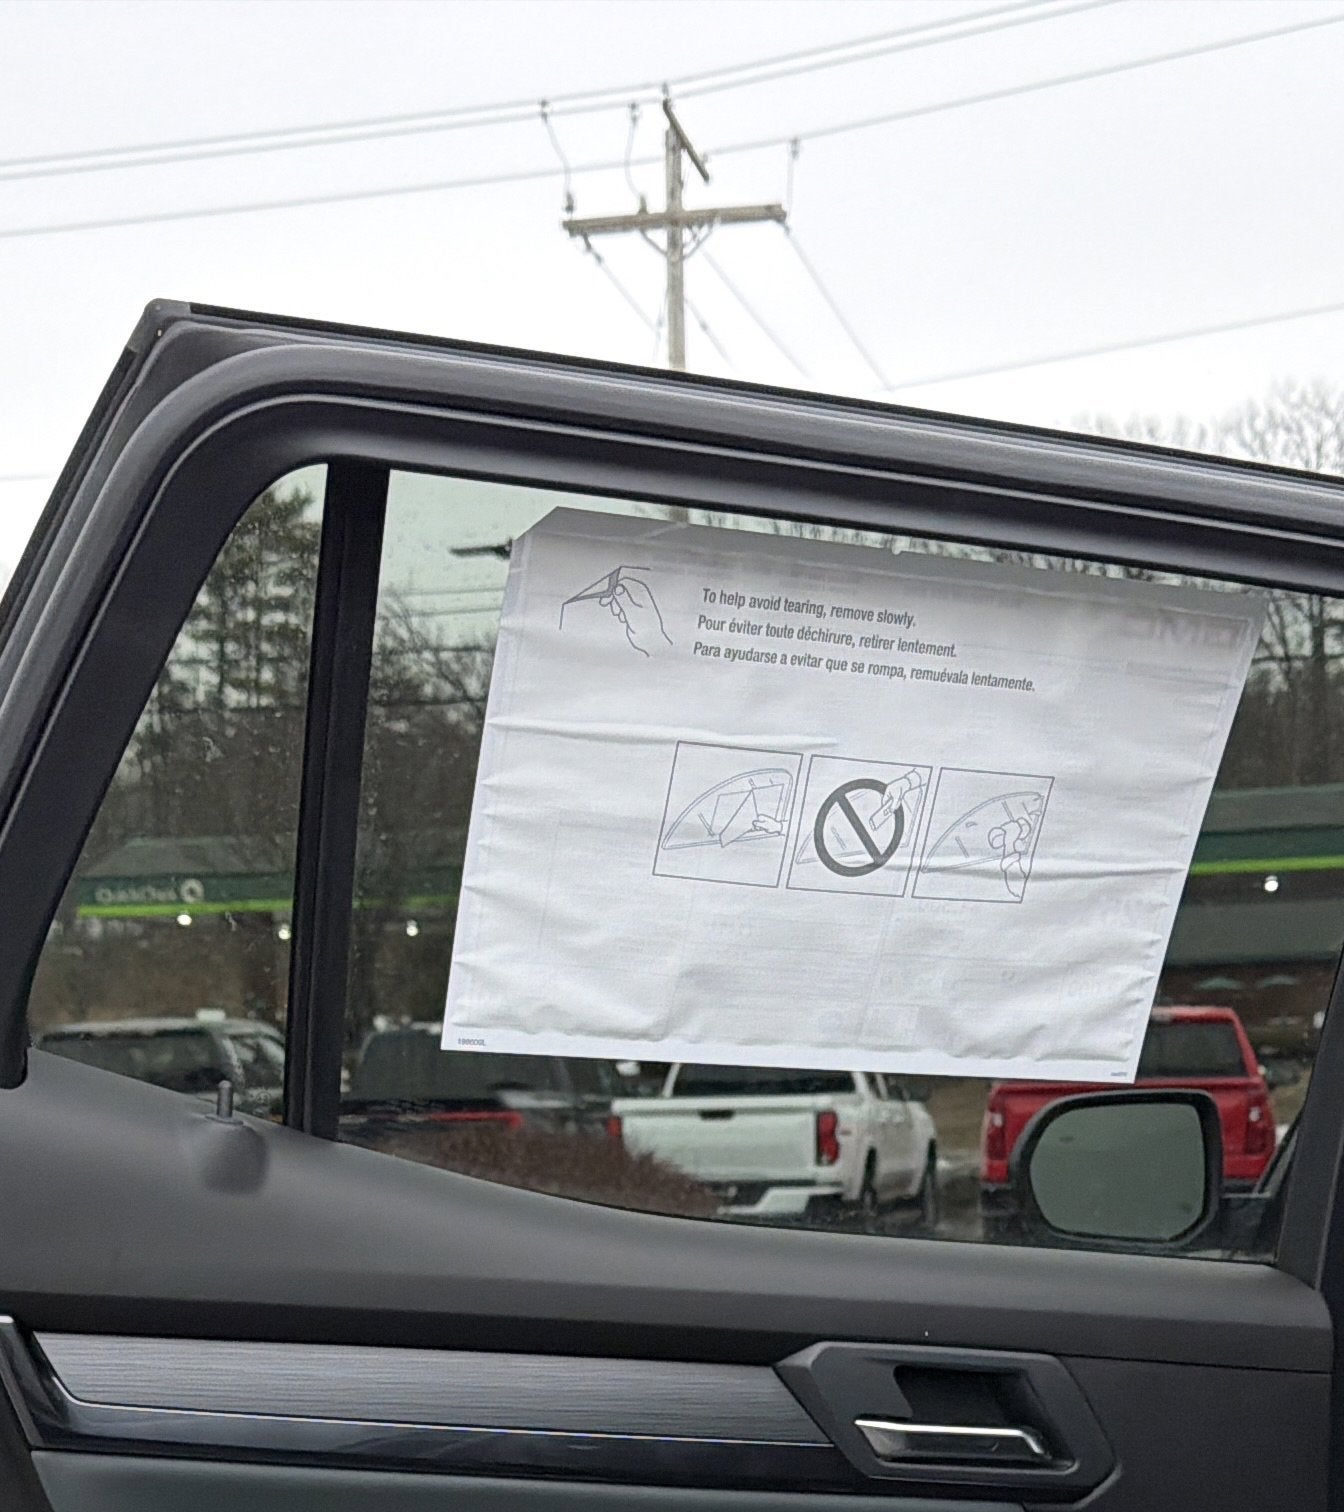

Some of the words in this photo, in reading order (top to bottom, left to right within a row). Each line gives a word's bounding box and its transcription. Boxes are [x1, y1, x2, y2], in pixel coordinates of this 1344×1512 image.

[702, 587, 717, 604] To
[720, 589, 746, 609] help
[749, 596, 781, 611] avoid
[783, 598, 827, 619] tearing,
[830, 605, 875, 622] remove
[876, 609, 916, 629] slowly.
[697, 614, 726, 631] Pour
[728, 617, 763, 636] éviter
[766, 622, 794, 639] toute
[797, 625, 856, 649] déchirure,
[859, 634, 895, 651] retirer
[897, 637, 957, 658] lentement.
[693, 641, 721, 658] Para
[724, 647, 777, 664] ayudarse
[780, 654, 788, 666] a
[790, 652, 824, 668] evitar
[826, 658, 848, 673] que
[851, 661, 864, 675] se
[867, 662, 907, 681] rompa,
[910, 667, 968, 685] remuévala
[971, 671, 1036, 692] lentamente.
